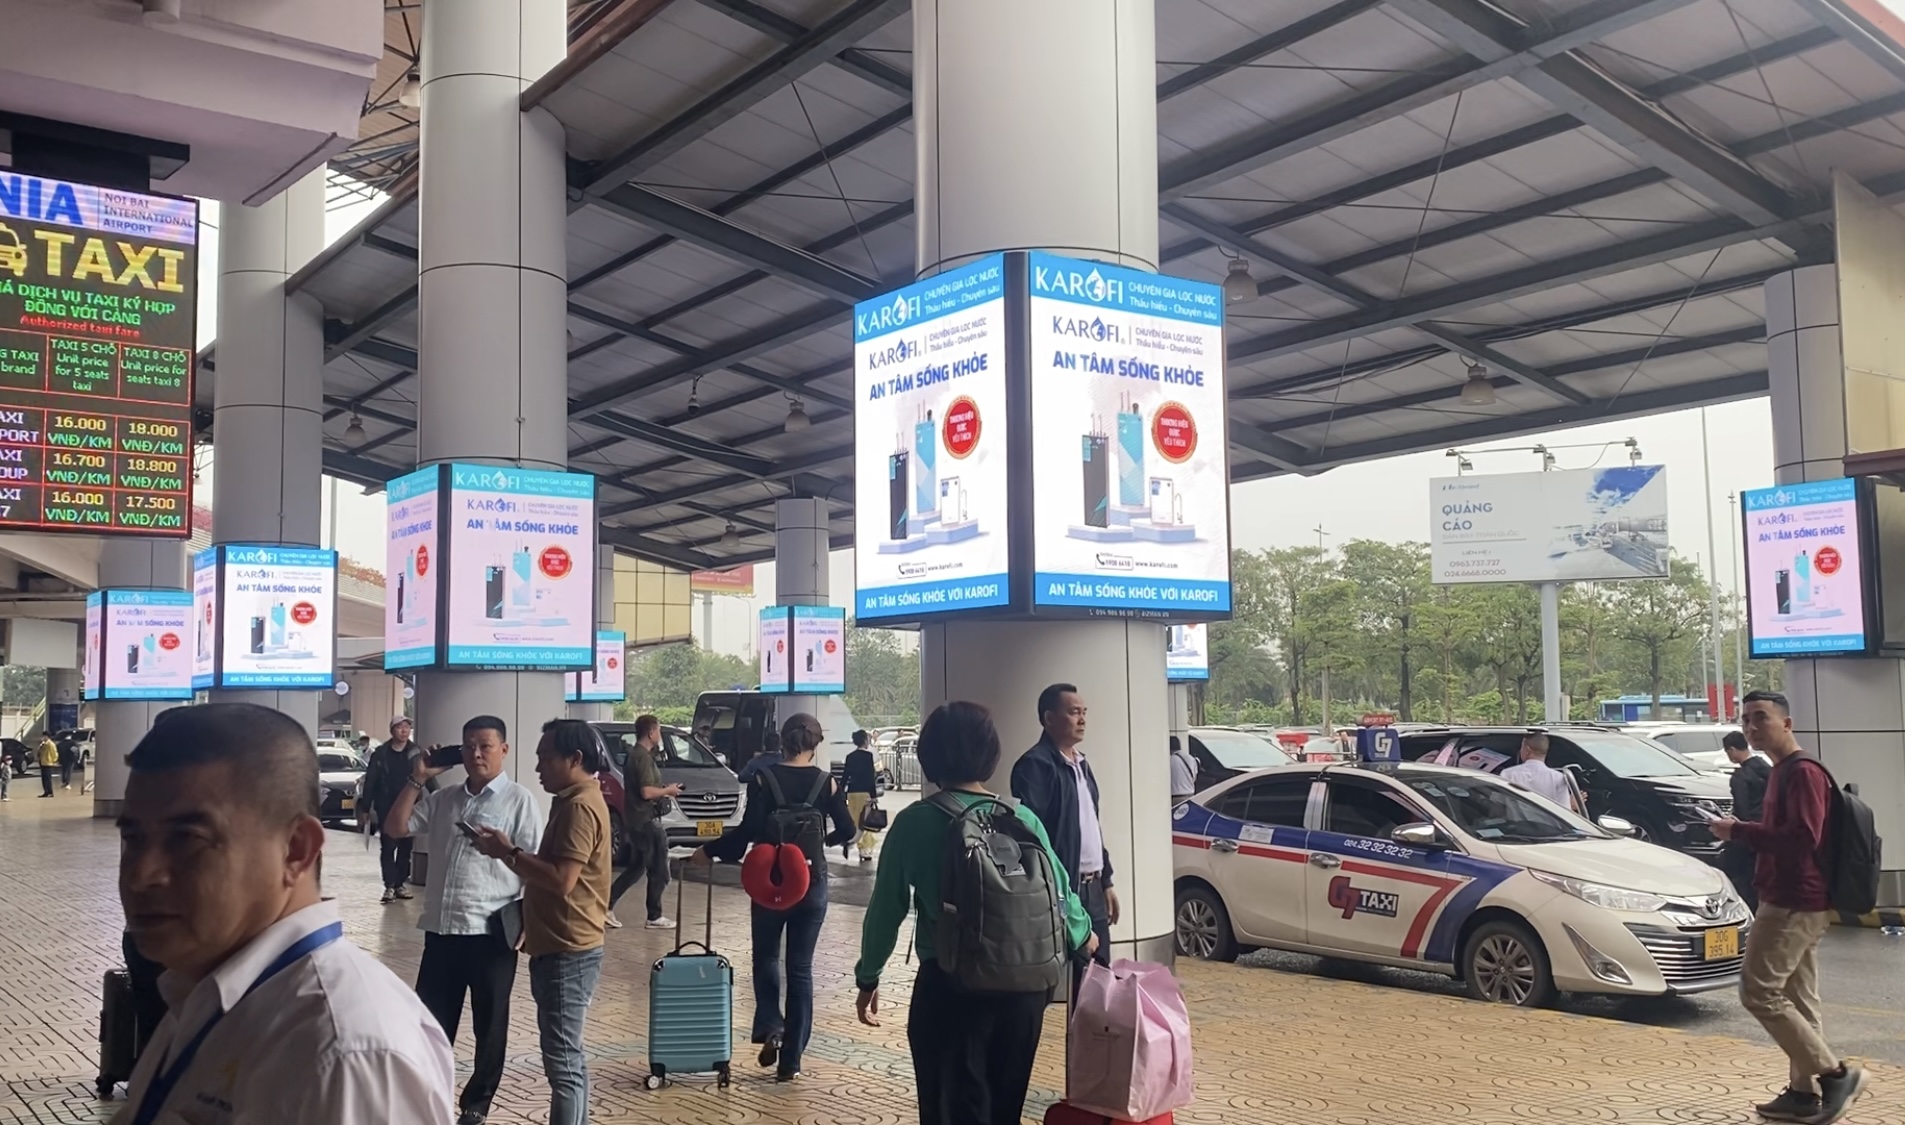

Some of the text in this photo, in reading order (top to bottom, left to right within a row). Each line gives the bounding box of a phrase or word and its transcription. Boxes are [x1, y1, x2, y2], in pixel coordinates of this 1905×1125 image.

[104, 192, 150, 209] NOI BAI
[103, 205, 193, 228] INTERNATIONAL
[103, 218, 153, 234] AIRPORT
[34, 229, 185, 293] TAXI
[1035, 267, 1123, 304] KAROFI
[1163, 287, 1177, 300] GIA
[18, 283, 57, 300] DỊCH
[61, 289, 81, 304] VỤ
[85, 292, 119, 308] TAXI
[123, 295, 141, 310] KÝ
[70, 304, 98, 320] VỚI
[857, 294, 921, 336] KAROFI
[20, 315, 140, 338] Authorized taxi fare
[1052, 315, 1120, 344] KAROFI
[51, 338, 78, 351] TAXI
[81, 342, 88, 351] 5
[10, 349, 40, 362] TAXI
[57, 352, 109, 369] Unit price
[124, 347, 150, 359] TAXI
[869, 337, 919, 371] KAROFI
[1, 361, 36, 375] brand
[55, 365, 110, 380] for 5 seats
[121, 359, 188, 376] Unit price for
[1053, 350, 1205, 388] AN TÂM SỐNG KHỎE
[127, 374, 151, 384] seats
[154, 375, 172, 386] taxi
[869, 351, 988, 402] AN TÂM SỐNG KHỎE
[73, 379, 92, 391] taxi
[54, 416, 106, 431] 16.000
[128, 422, 178, 437] 18.000
[47, 433, 112, 449] VNĐ/KM
[121, 438, 183, 454] VNĐ/KM
[53, 453, 105, 468] 16.700
[127, 458, 177, 473] 18.800
[46, 470, 110, 486] VNĐ/KM
[120, 475, 182, 490] VNĐ/KM
[455, 469, 520, 491] KAROFI
[52, 491, 104, 506] 16.000
[126, 496, 175, 510] 17.500
[467, 498, 517, 513] KAROFI
[1748, 489, 1796, 508] KAROFI
[45, 508, 109, 523] VNĐ/KM
[1442, 500, 1494, 517] QUẢNG
[119, 512, 181, 528] VNĐ/KM
[467, 519, 484, 530] AN
[515, 519, 546, 533] SỐNG
[548, 522, 579, 535] KHỎE
[1442, 518, 1473, 532] CÁO
[1757, 512, 1796, 526] KAROFI
[1758, 523, 1845, 543] AN TÂM SỐNG KHỎE
[228, 548, 278, 564] KAROFI
[236, 568, 275, 579] KAROFI
[236, 584, 249, 592] AN
[251, 582, 271, 593] TÂM
[272, 582, 297, 594] SỐNG
[865, 596, 877, 609] AN
[878, 592, 896, 609] TÂM
[964, 583, 998, 601] KAROFI
[1049, 580, 1219, 602] AN TÂM SỐNG KHỎE VỚI KAROFI
[554, 652, 583, 660] KAROFI
[1374, 731, 1393, 758] G7
[1360, 890, 1398, 912] TAXI
[1715, 929, 1729, 943] 30G
[1709, 942, 1735, 958] 395.14
